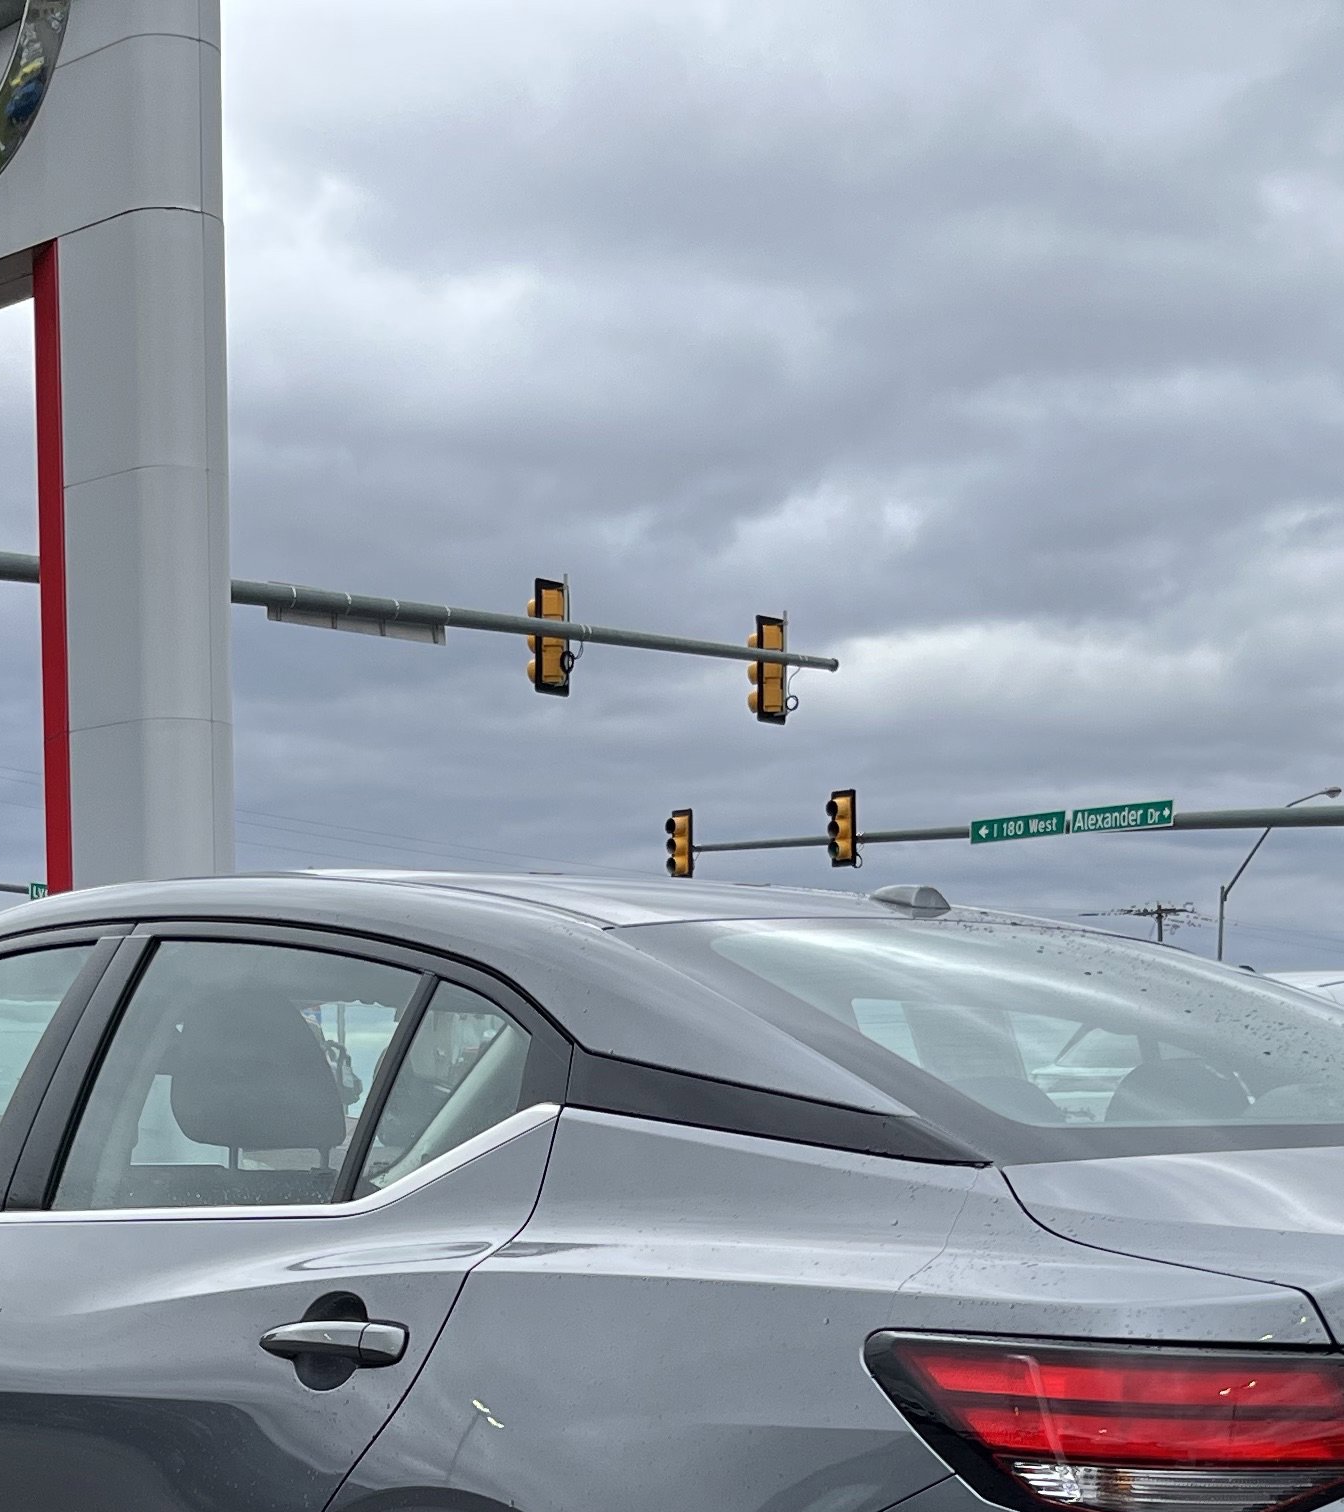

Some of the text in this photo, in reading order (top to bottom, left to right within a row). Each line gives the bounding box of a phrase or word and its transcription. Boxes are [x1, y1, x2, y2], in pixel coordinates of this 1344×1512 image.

[1003, 820, 1024, 837] 180
[1028, 817, 1057, 834] West
[1073, 806, 1161, 832] Alexander Dr
